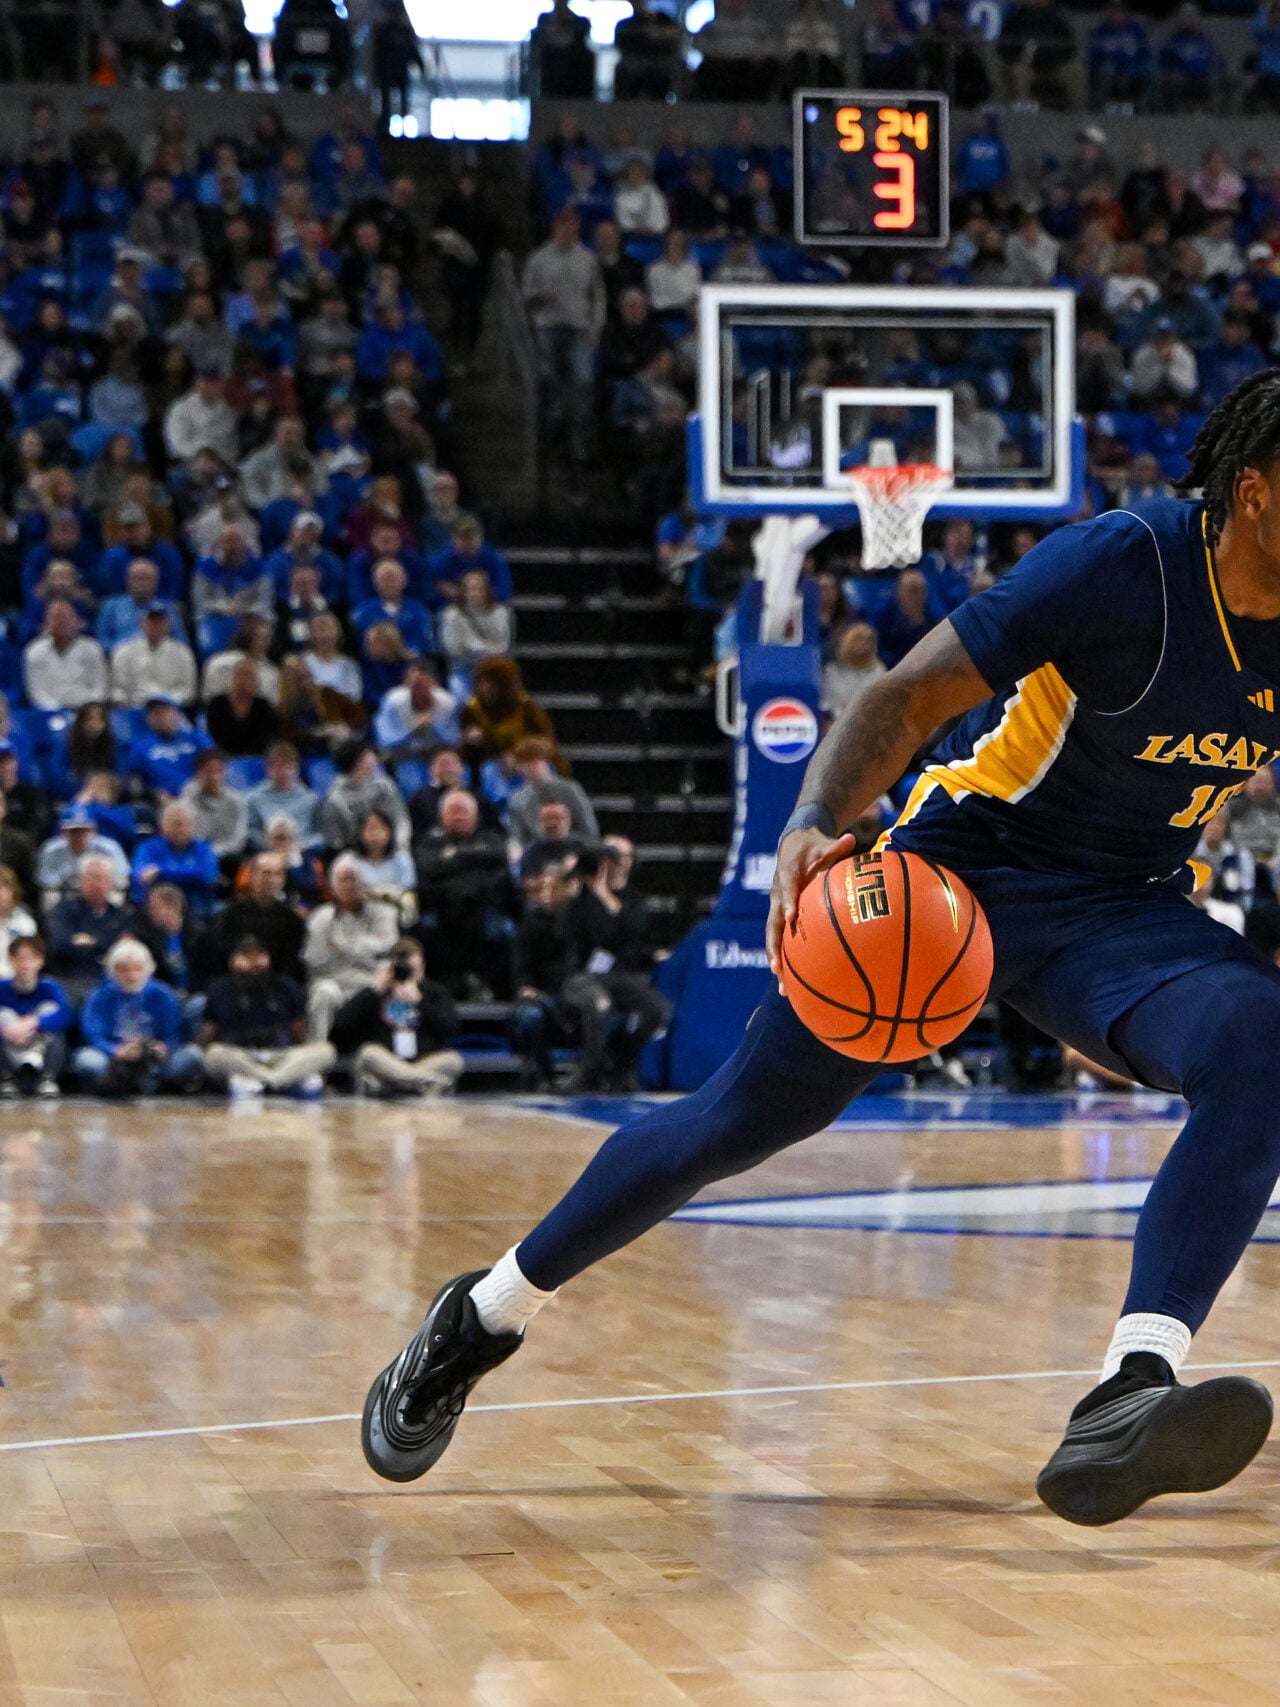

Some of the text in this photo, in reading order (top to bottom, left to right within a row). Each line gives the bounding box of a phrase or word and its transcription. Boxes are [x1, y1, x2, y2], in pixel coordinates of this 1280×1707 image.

[835, 106, 929, 153] 5 24
[872, 151, 916, 230] 3
